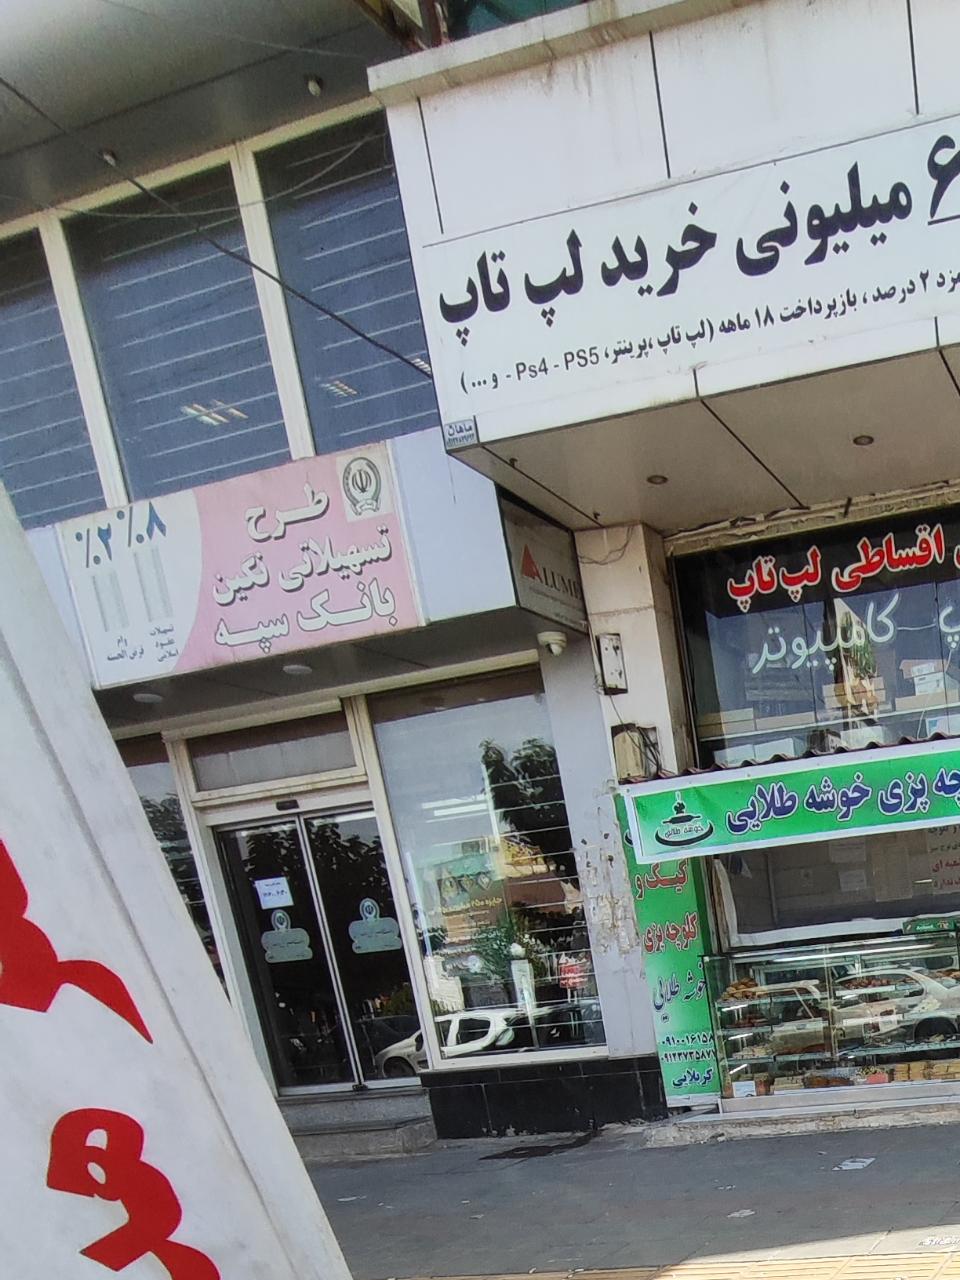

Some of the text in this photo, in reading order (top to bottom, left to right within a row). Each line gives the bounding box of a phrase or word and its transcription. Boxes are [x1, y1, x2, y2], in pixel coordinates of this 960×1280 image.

[735, 160, 913, 277] میلیونی
[600, 202, 718, 298] خرید
[438, 250, 511, 347] تاپ
[523, 229, 584, 327] لپ
[871, 278, 917, 303] درصد
[718, 312, 751, 335] ماهه
[754, 303, 776, 327] ۱۸
[779, 288, 858, 323] بازپرداخت
[564, 345, 600, 373] PS5
[657, 324, 682, 354] تاپ
[516, 354, 549, 381] Ps4
[245, 482, 330, 543] طرح
[212, 524, 392, 607] تسهیلاتی نگین
[780, 546, 822, 602] لپ
[832, 523, 946, 593] اقساطی
[727, 555, 777, 613] تاپ
[214, 577, 398, 653] بانک سپه
[726, 781, 798, 835] طلایی
[804, 772, 872, 821] خوشه
[878, 772, 930, 816] پزی
[635, 859, 688, 899] کیک و
[643, 912, 698, 953] کلوچه پزی
[653, 973, 680, 1022] طلایی
[661, 1031, 714, 1046] ۰۹۱۰۰۱۶۱۵۸
[672, 1068, 713, 1088] کربلایی
